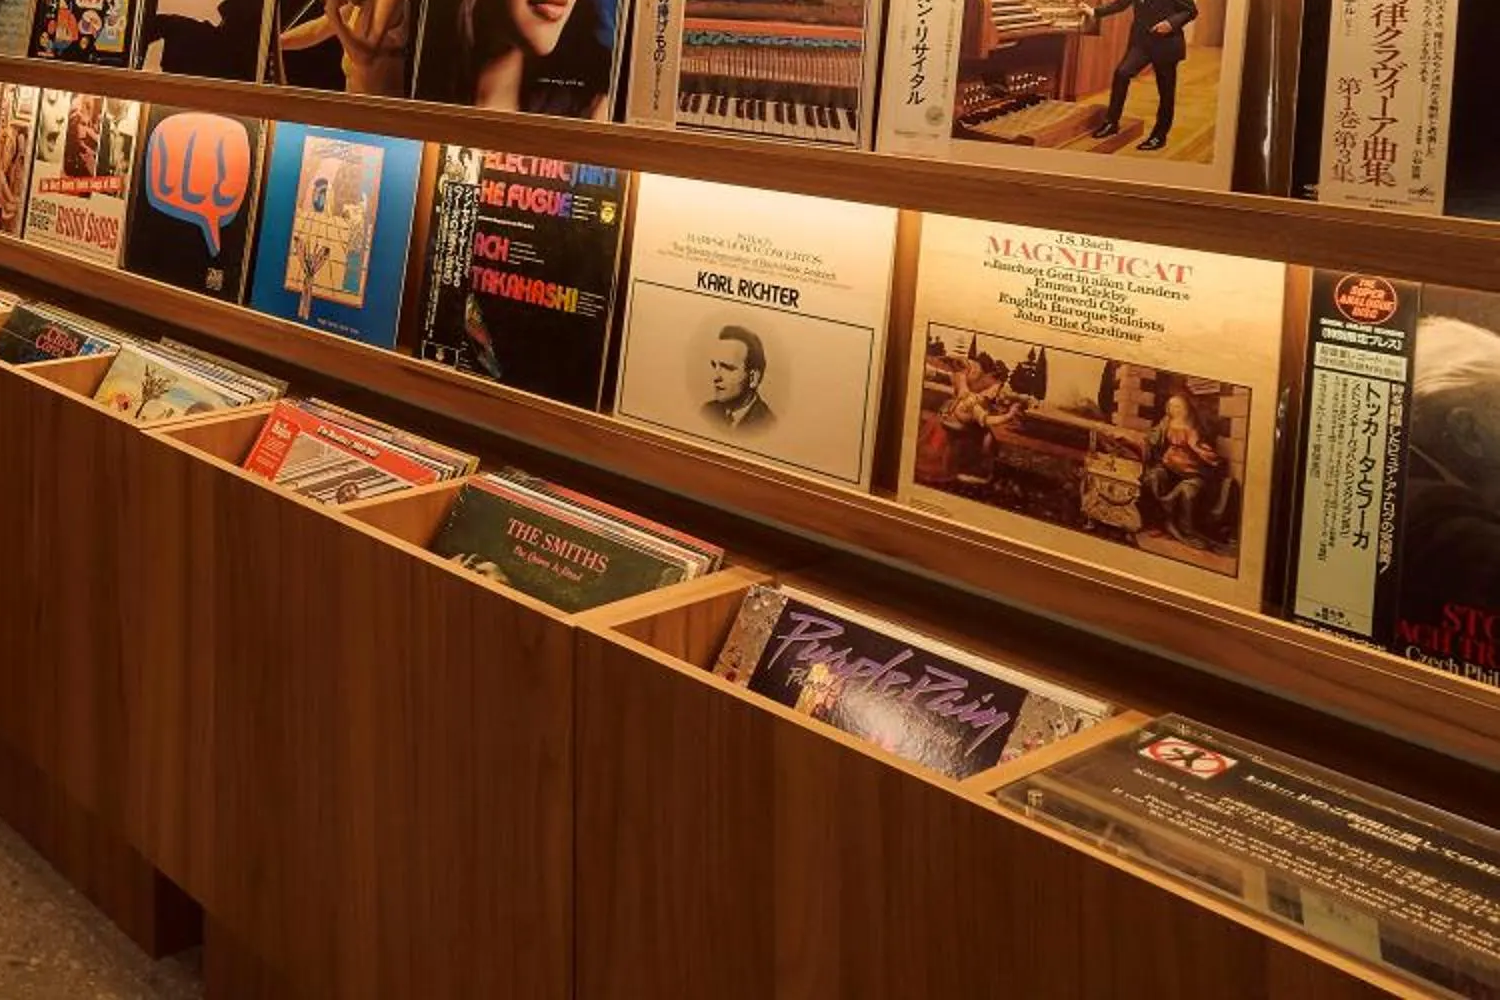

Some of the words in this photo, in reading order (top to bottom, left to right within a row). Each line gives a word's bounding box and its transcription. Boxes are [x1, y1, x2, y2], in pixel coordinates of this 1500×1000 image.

[480, 180, 506, 206] HE
[506, 183, 573, 217] FUGUE
[473, 231, 510, 263] ACH
[987, 235, 1194, 285] MAGNIFICAT
[1080, 235, 1115, 252] Bach
[472, 265, 579, 313] TAKAHASHI
[697, 270, 735, 295] KARL
[737, 278, 800, 309] RICHTER
[1035, 277, 1078, 293] Emma
[1080, 285, 1128, 304] Kirkby
[1045, 267, 1074, 283] Gott
[1075, 273, 1090, 284] in
[998, 292, 1048, 311] English
[1050, 302, 1108, 322] Baroque
[1109, 313, 1165, 333] Soloists
[1026, 287, 1097, 309] Monteverdi
[1098, 299, 1138, 316] Choir
[1013, 308, 1046, 325] John
[1080, 321, 1145, 342] Gardiner
[1351, 382, 1381, 550] トッカータとフーガ
[507, 518, 543, 547] THE
[541, 533, 610, 573] SMITHS
[1405, 645, 1460, 675] Czech
[768, 610, 914, 690] Purple
[902, 664, 1011, 758] Rain
